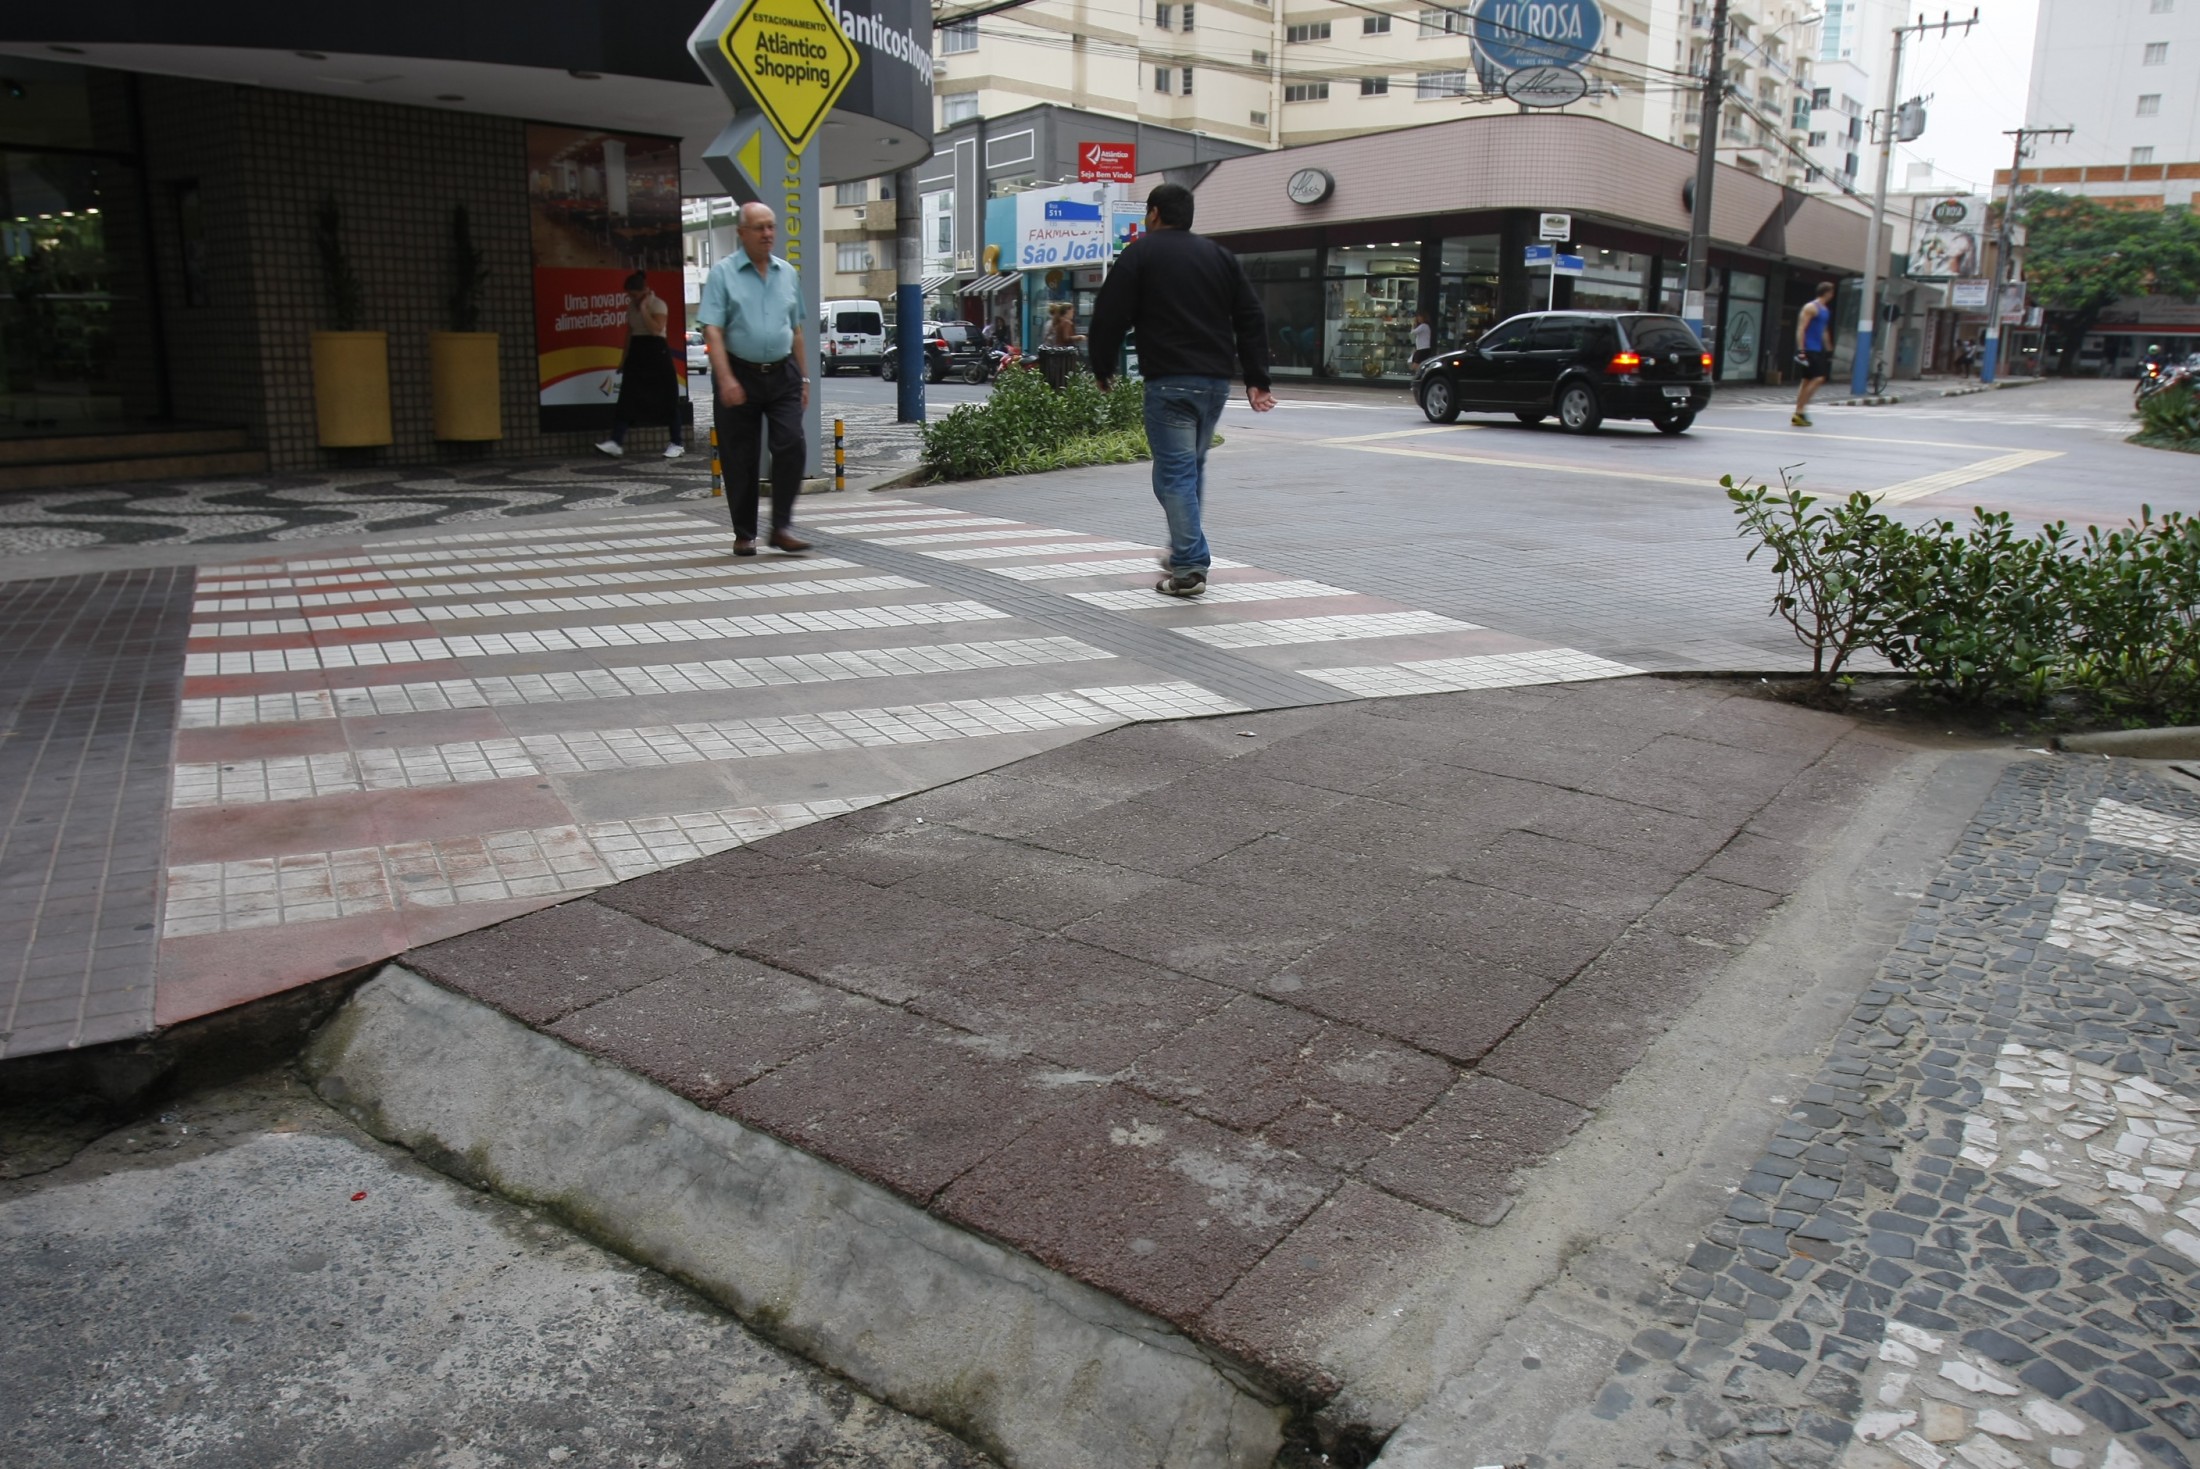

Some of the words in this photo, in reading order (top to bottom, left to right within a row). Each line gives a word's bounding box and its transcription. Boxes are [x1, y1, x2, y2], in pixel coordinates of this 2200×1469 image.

[752, 12, 827, 32] ESTACIONAMENTO
[755, 31, 827, 60] Atlântico
[754, 54, 830, 89] Shopping
[1080, 171, 1094, 179] Seja
[1112, 171, 1133, 179] Vindo
[1049, 209, 1062, 217] 511
[1022, 242, 1058, 265] São
[1062, 237, 1111, 262] João
[564, 294, 589, 311] Uma
[590, 293, 615, 309] nova
[555, 309, 616, 332] alimentação
